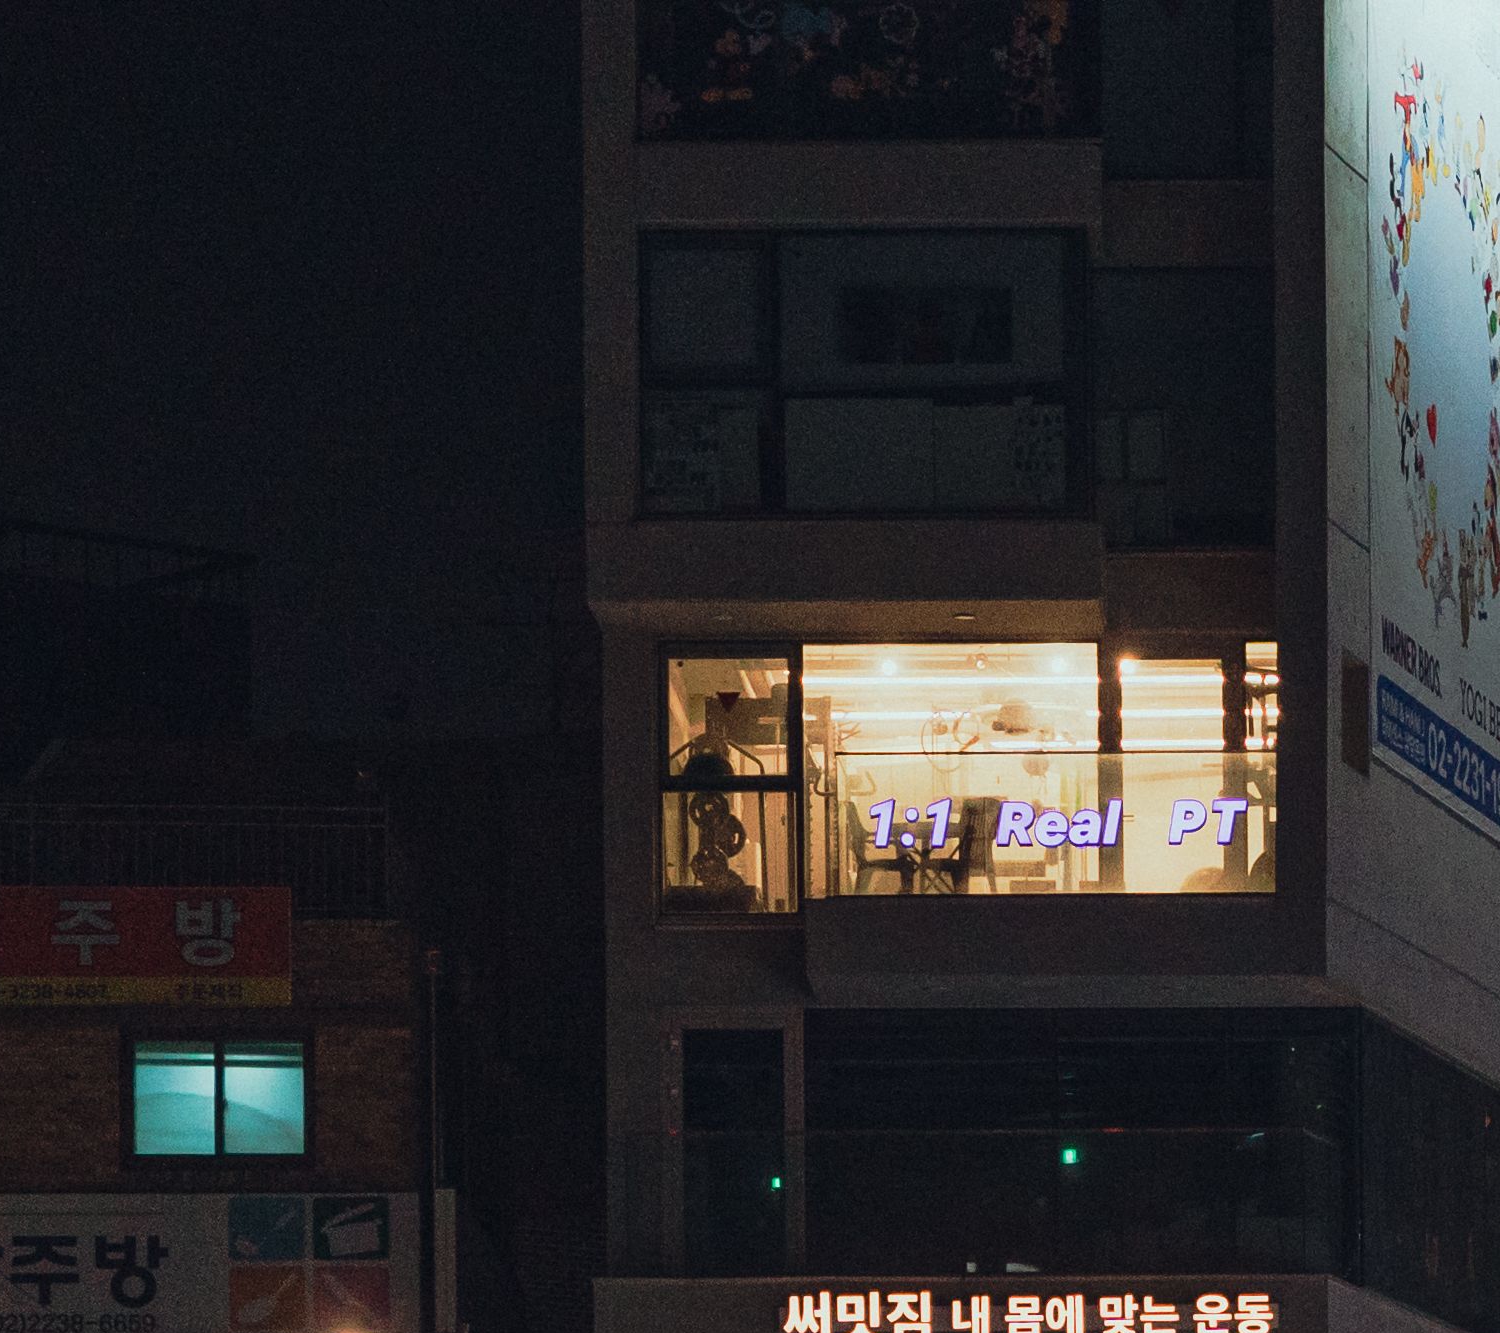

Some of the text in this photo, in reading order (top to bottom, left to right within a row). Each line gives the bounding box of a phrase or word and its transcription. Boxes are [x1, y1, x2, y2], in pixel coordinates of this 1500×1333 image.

[1381, 614, 1418, 677] WARNER
[1459, 676, 1487, 728] YOGI
[868, 798, 1250, 850] 1:1 Real PT
